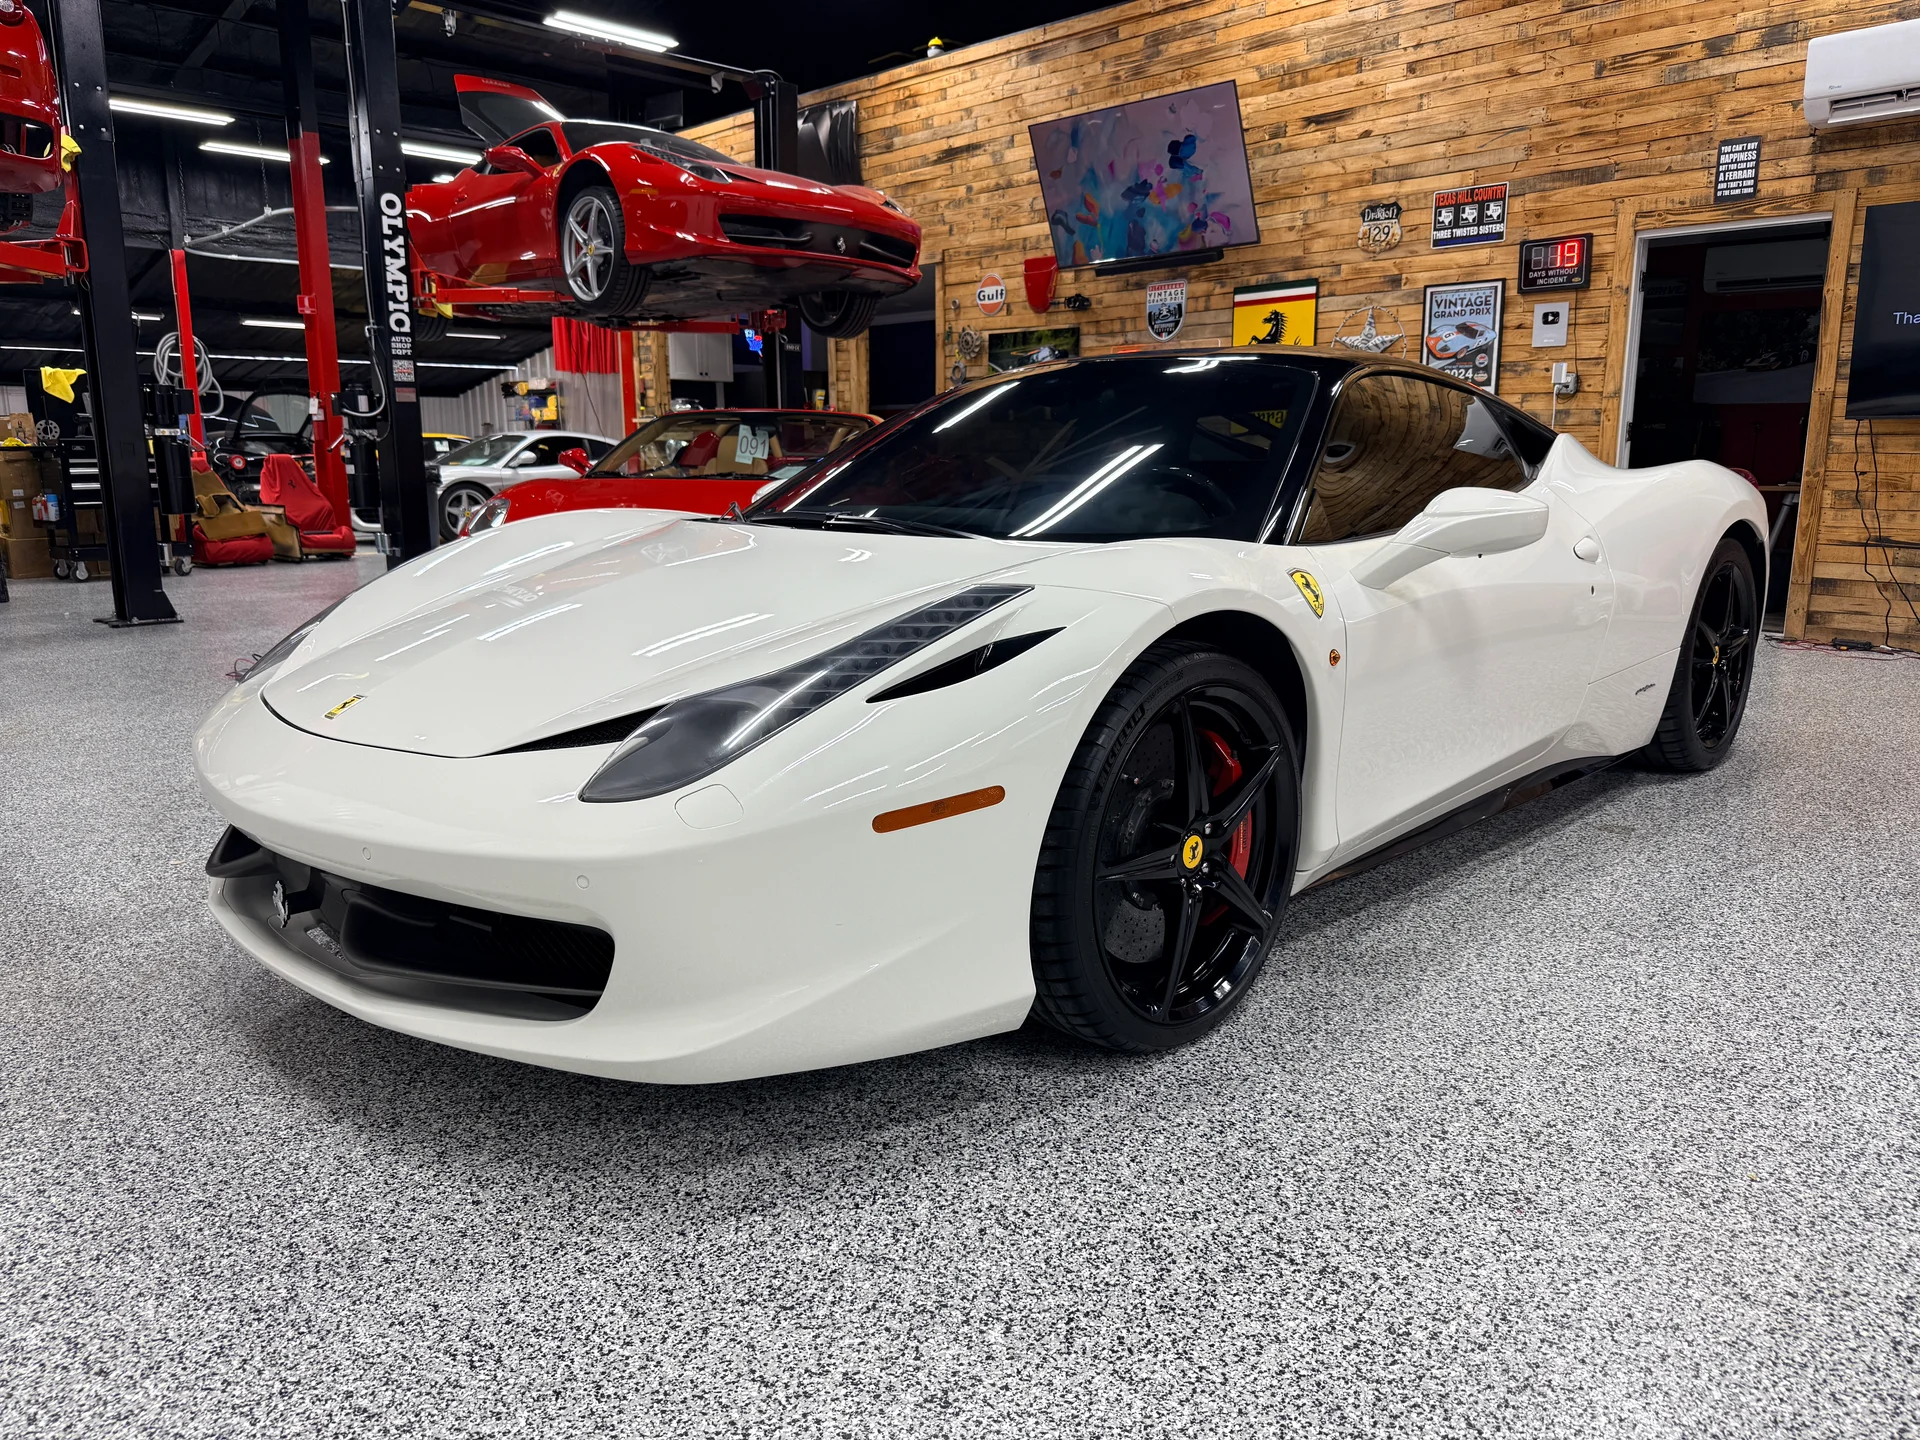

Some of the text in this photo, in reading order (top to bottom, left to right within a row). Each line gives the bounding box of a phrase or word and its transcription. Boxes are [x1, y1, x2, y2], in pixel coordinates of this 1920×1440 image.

[1721, 142, 1758, 153] YOU CAN'T BUY
[1720, 151, 1757, 163] HAPPINESS
[1719, 169, 1755, 181] A FERRARI
[1743, 179, 1754, 187] KIND
[1435, 185, 1506, 206] TEXAS HILL COUNTRY
[1368, 225, 1390, 243] 129
[1433, 229, 1452, 240] THREE
[1453, 226, 1478, 237] TWISTED
[1479, 223, 1504, 235] SISTERS
[1556, 242, 1577, 267] 19
[380, 192, 411, 333] OLYMPIC
[1529, 267, 1578, 278] DAYS WITHOUT
[1537, 276, 1567, 285] INCIDENT
[977, 288, 1005, 301] Gulf
[1148, 289, 1184, 299] VINTAGE
[1435, 295, 1492, 309] VINTAGE
[1434, 307, 1491, 318] GRAND PRIX
[1893, 311, 1920, 325] Tha
[740, 435, 766, 457] 091
[1097, 705, 1144, 786] MICHELIN
